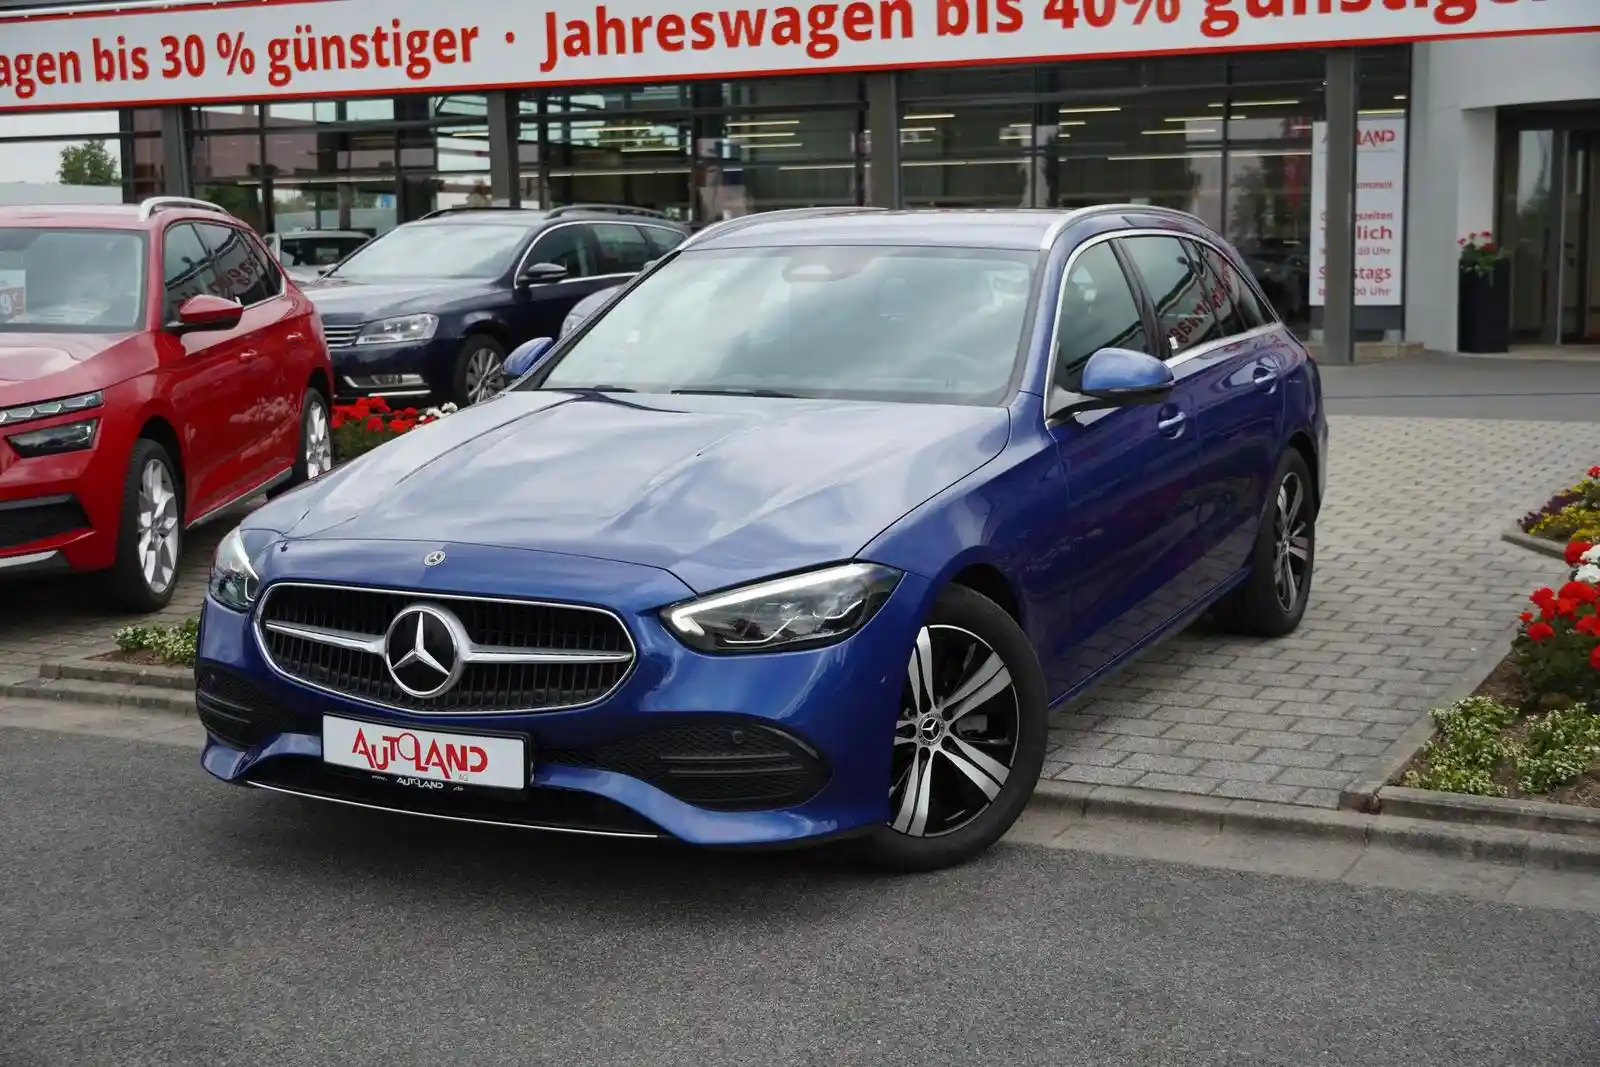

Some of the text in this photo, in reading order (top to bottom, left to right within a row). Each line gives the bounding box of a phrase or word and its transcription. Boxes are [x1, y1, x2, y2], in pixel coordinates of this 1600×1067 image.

[92, 35, 149, 81] bis
[160, 34, 206, 78] 30
[216, 31, 256, 76] %
[267, 18, 479, 88] günstiger
[539, 0, 914, 73] Jahreswagen
[936, 0, 1024, 37] bis
[352, 727, 489, 780] AUTOLAND
[396, 777, 444, 790] AUTOLAND
